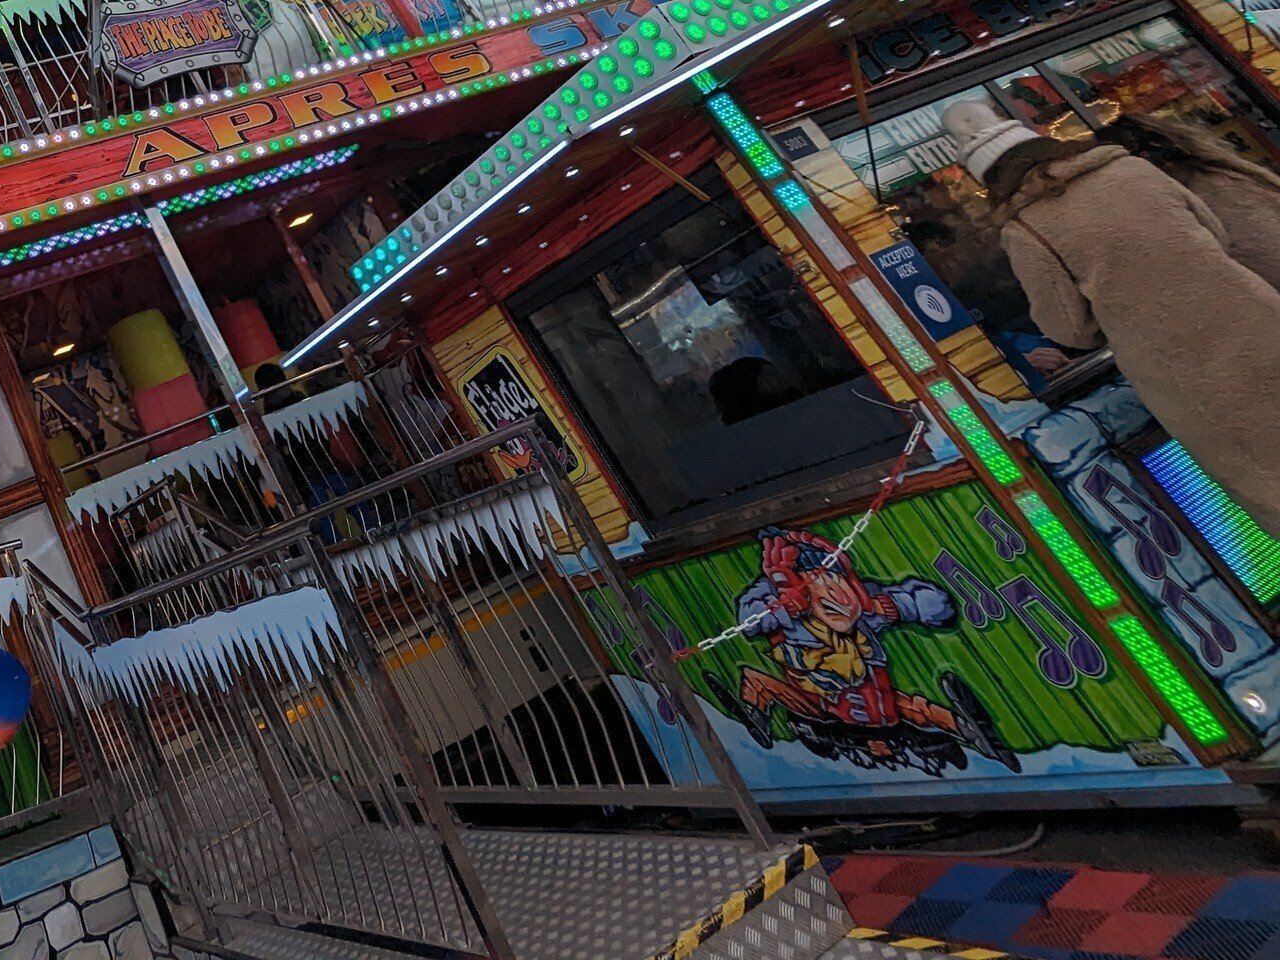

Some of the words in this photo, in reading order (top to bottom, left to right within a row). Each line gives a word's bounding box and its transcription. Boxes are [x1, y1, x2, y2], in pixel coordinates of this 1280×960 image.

[110, 20, 151, 60] THE
[141, 15, 196, 54] PLACE
[181, 10, 210, 46] TO
[201, 6, 233, 43] BE
[878, 245, 915, 270] ACCEPTED
[895, 261, 919, 280] HERE
